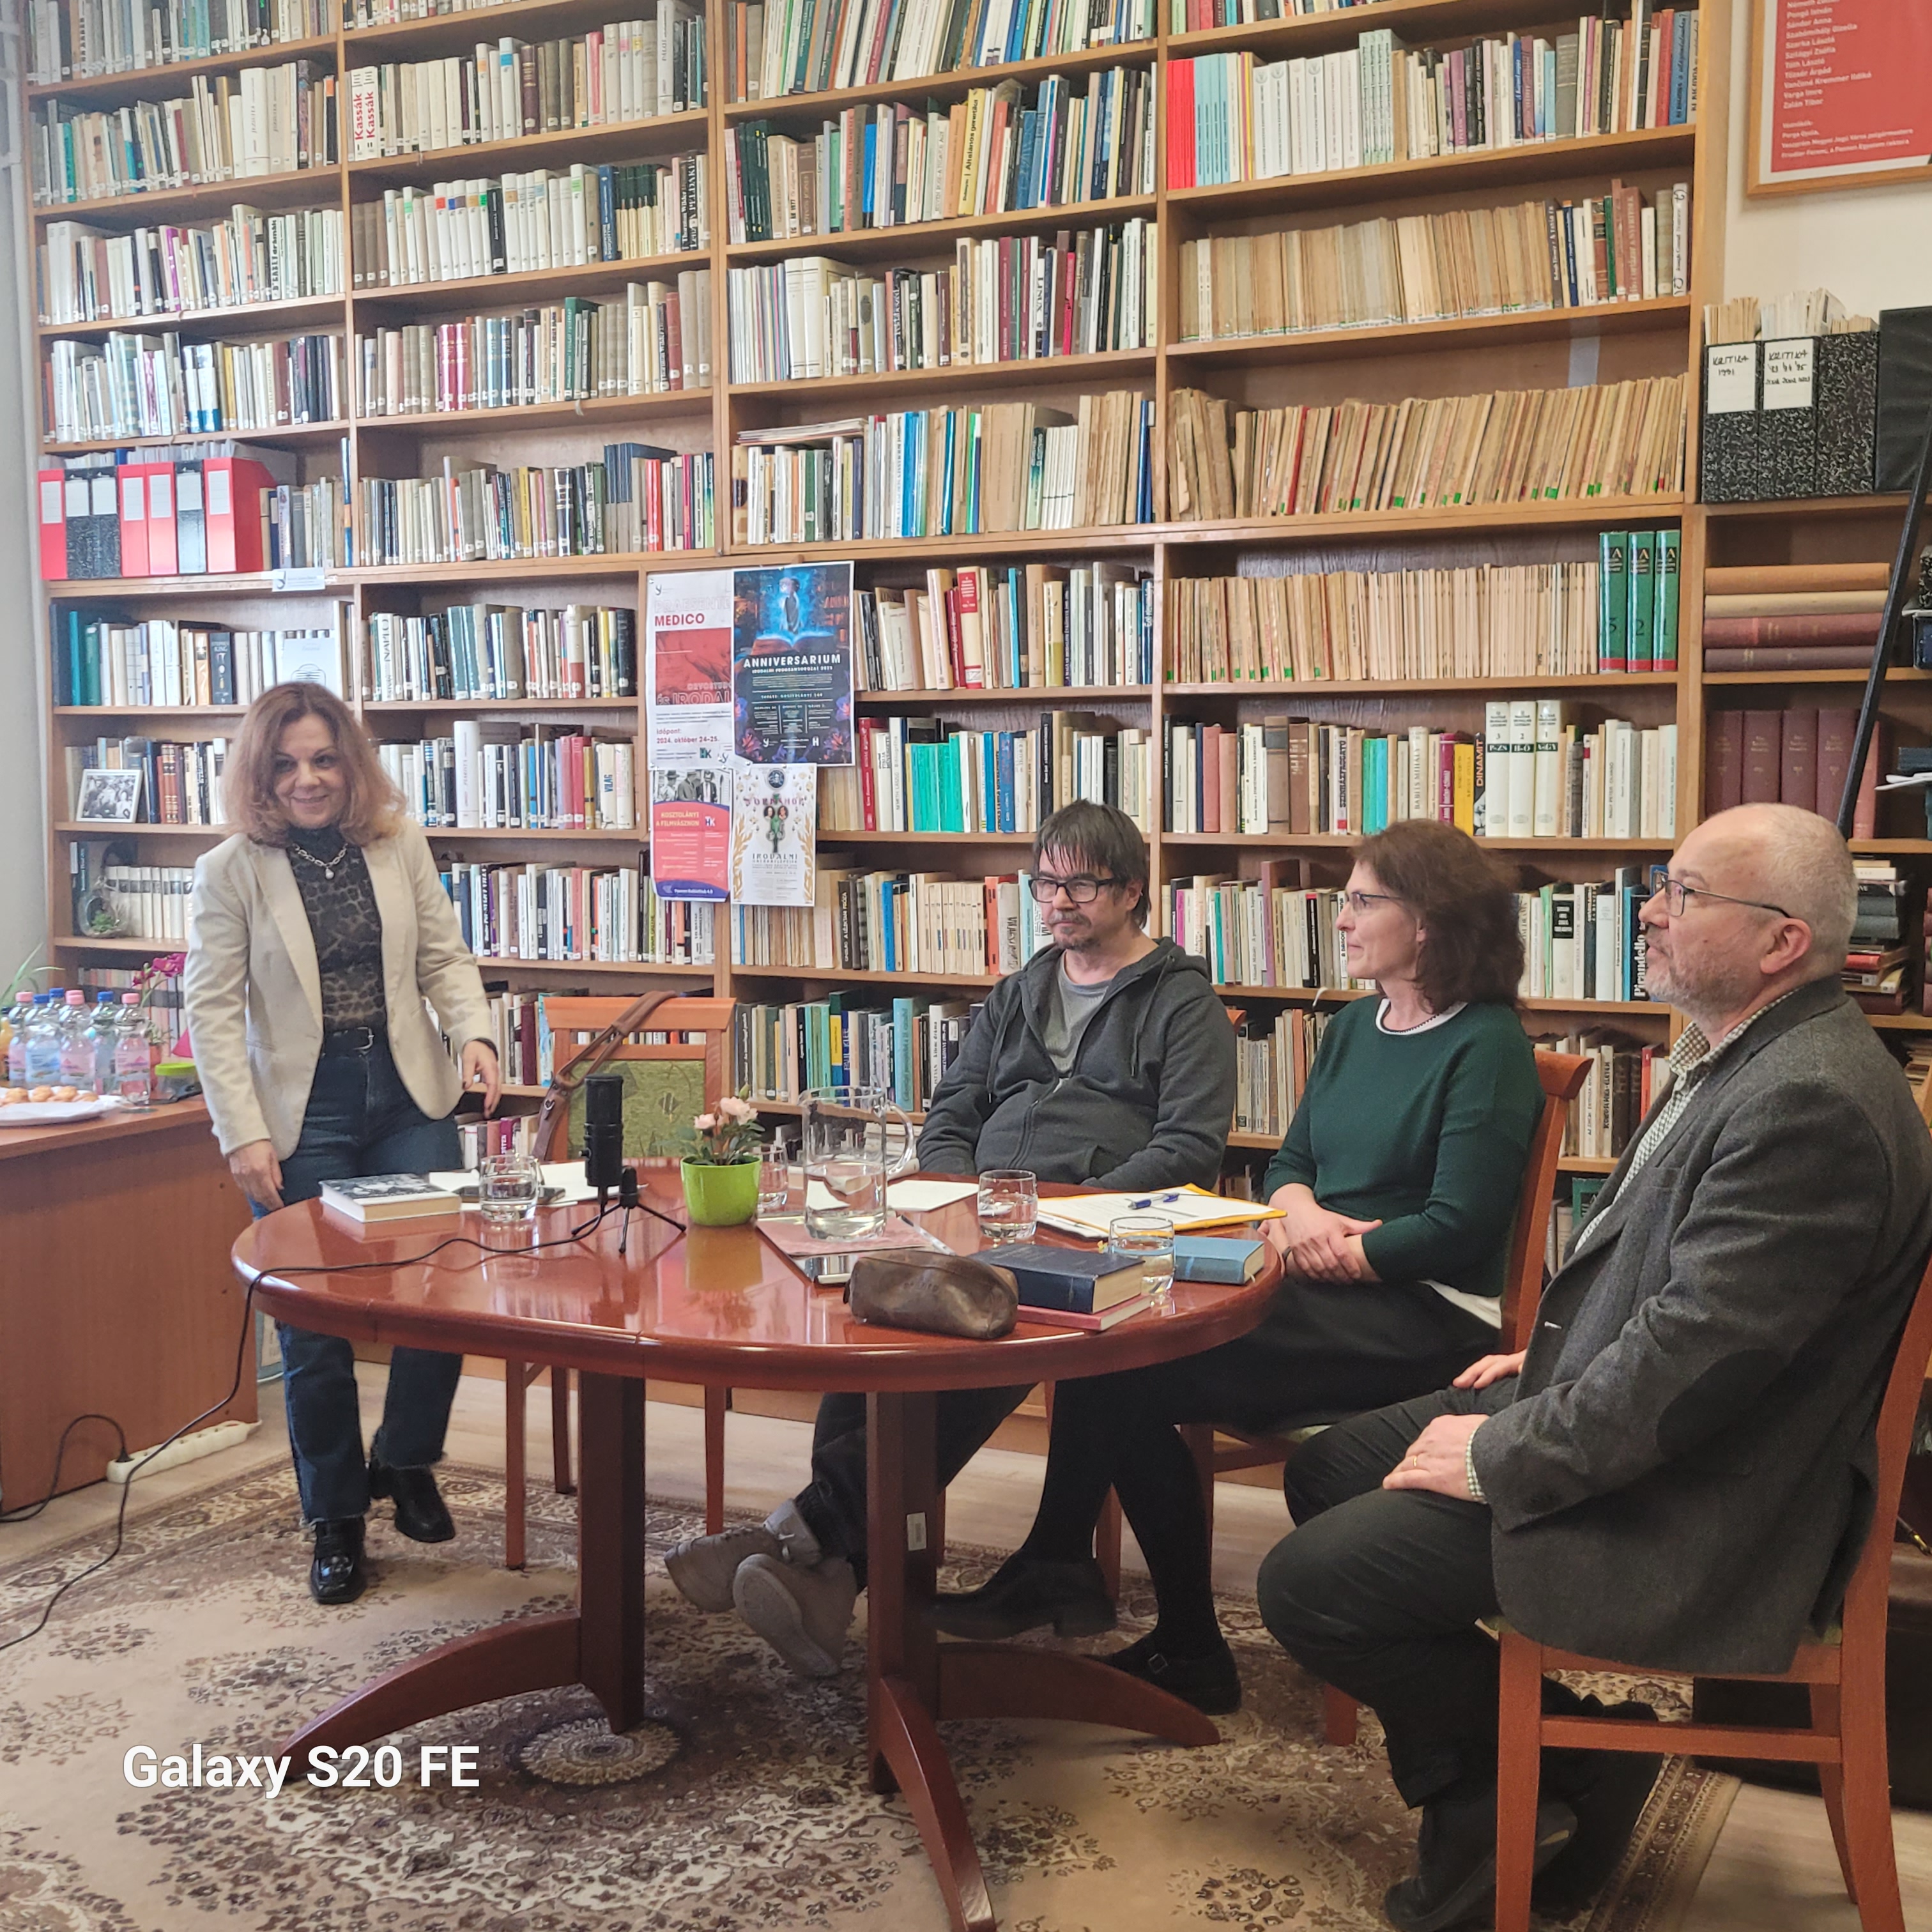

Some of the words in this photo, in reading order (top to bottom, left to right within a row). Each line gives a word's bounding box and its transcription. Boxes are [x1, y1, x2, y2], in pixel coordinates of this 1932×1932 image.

[353, 93, 364, 140] Kassák
[364, 91, 375, 138] Kassák
[969, 99, 979, 132] genetika
[655, 613, 705, 627] MEDICO
[743, 654, 841, 668] ANNIVERSARIUM
[1634, 935, 1647, 998] Pirandello
